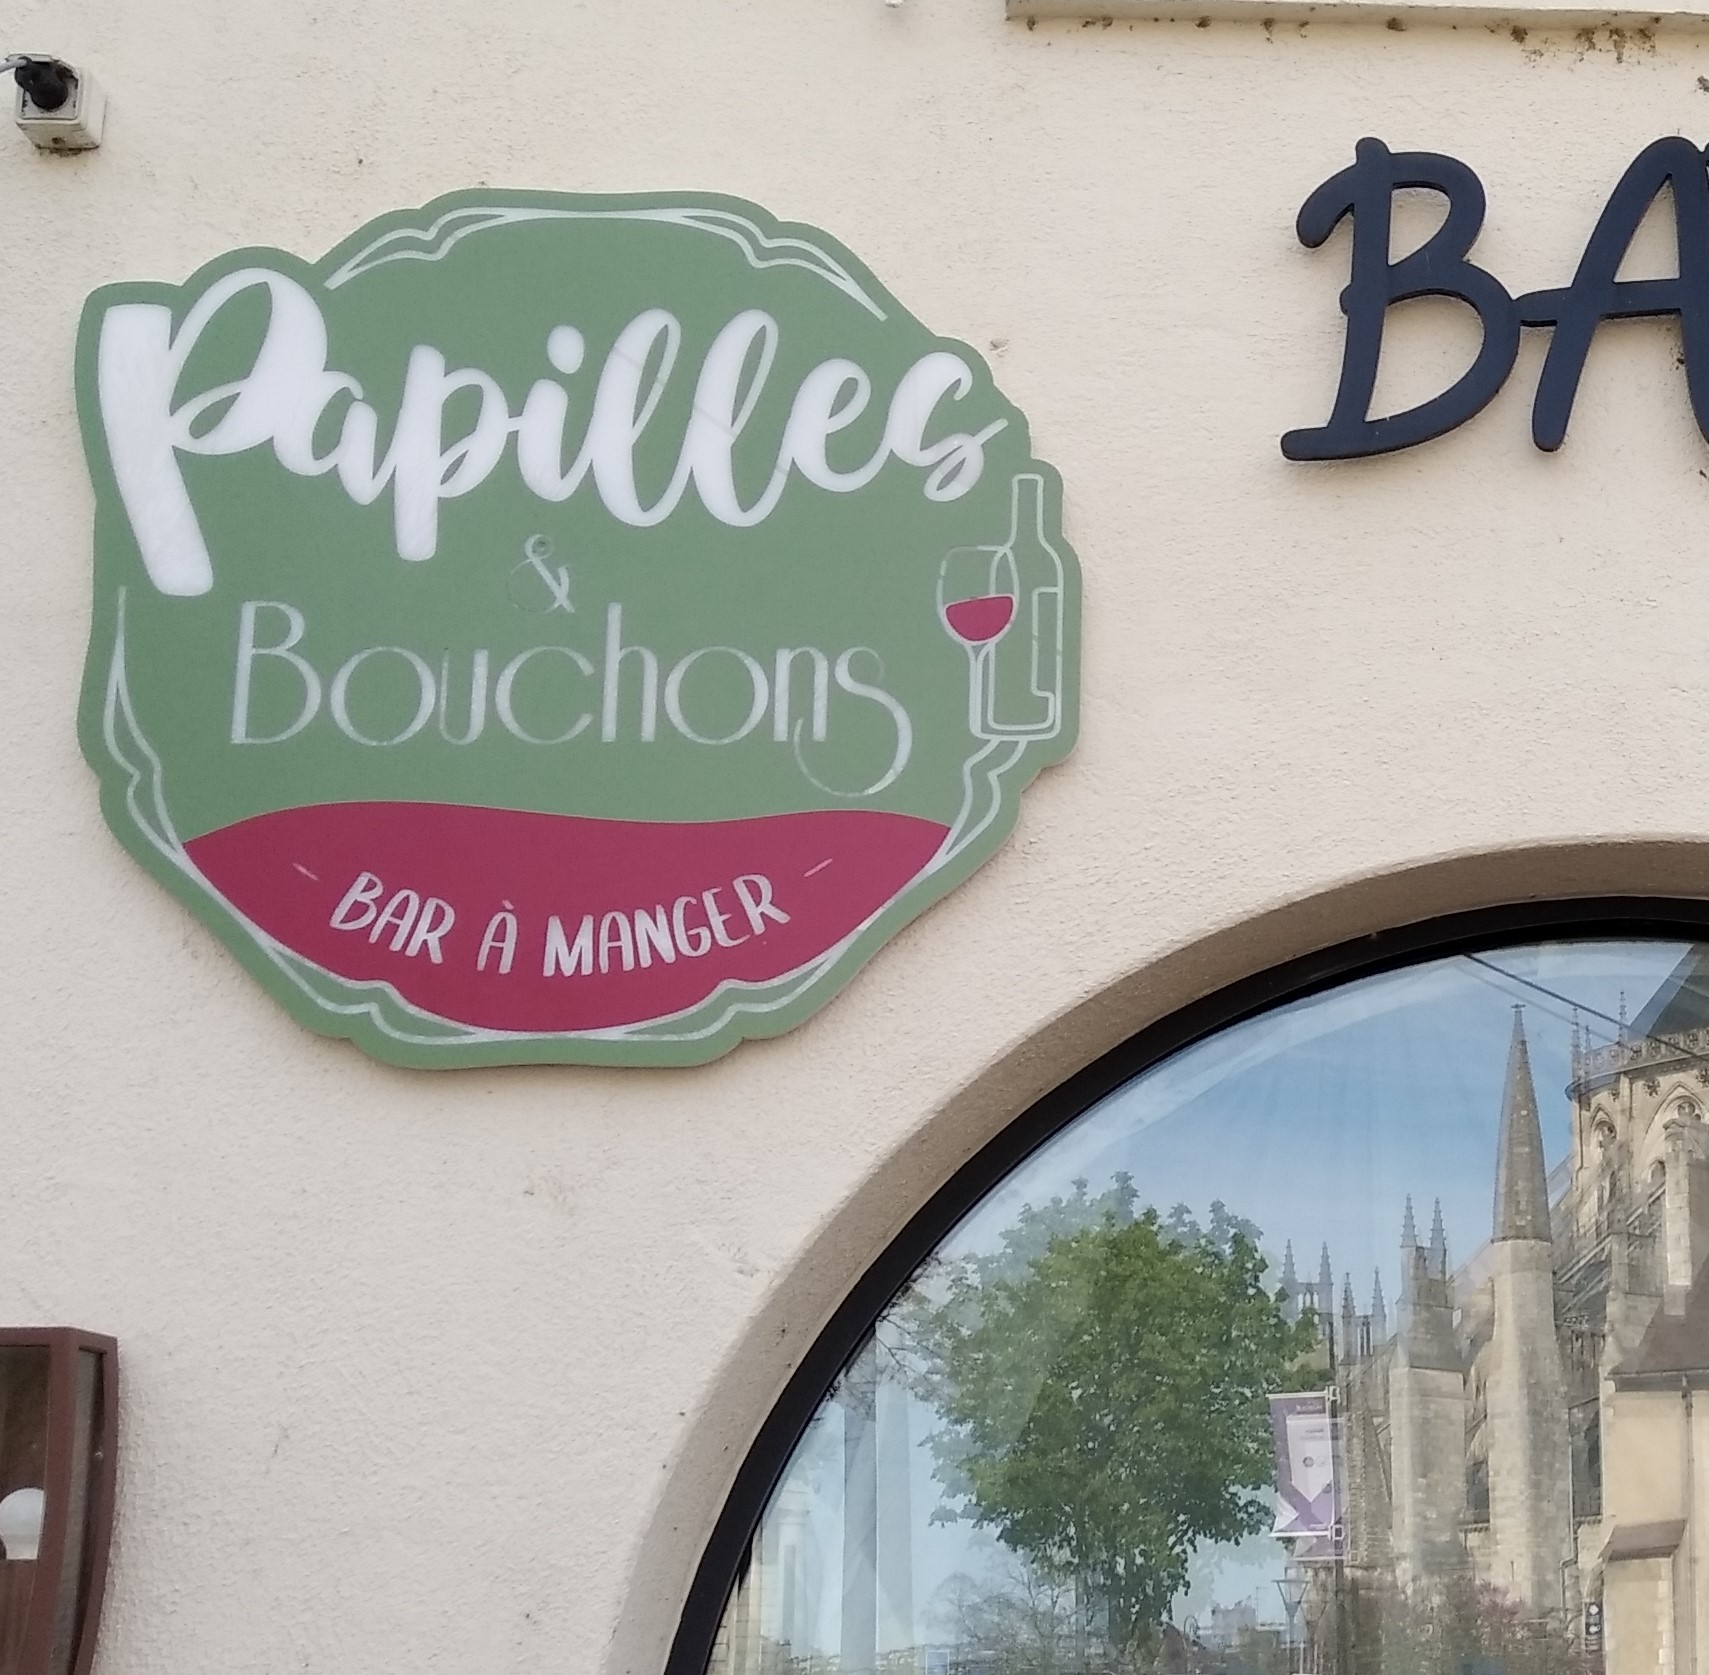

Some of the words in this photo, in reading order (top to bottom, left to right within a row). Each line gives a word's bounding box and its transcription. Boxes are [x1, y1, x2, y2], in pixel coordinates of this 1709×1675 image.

[98, 267, 1008, 597] Papilles
[505, 534, 576, 614] &
[230, 600, 914, 797] Bouchons
[329, 871, 455, 964] BAR
[477, 901, 518, 975] À
[542, 873, 791, 978] MANGER
